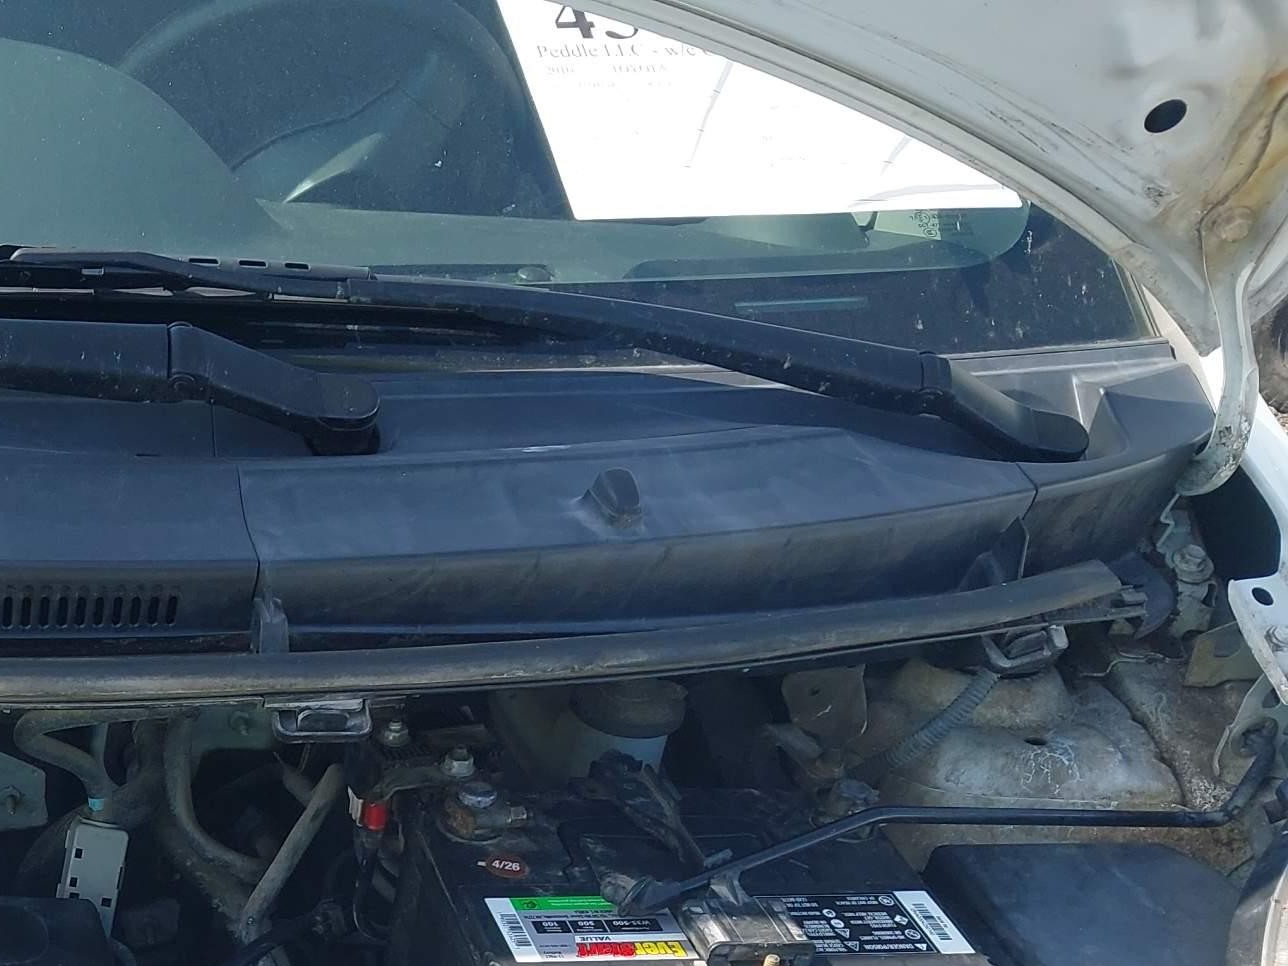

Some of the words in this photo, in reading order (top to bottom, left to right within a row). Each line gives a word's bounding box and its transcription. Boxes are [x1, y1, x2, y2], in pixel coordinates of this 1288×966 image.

[536, 43, 598, 58] Peddle
[604, 44, 641, 57] LLC
[491, 859, 520, 871] 4/26
[576, 941, 688, 959] EverStart
